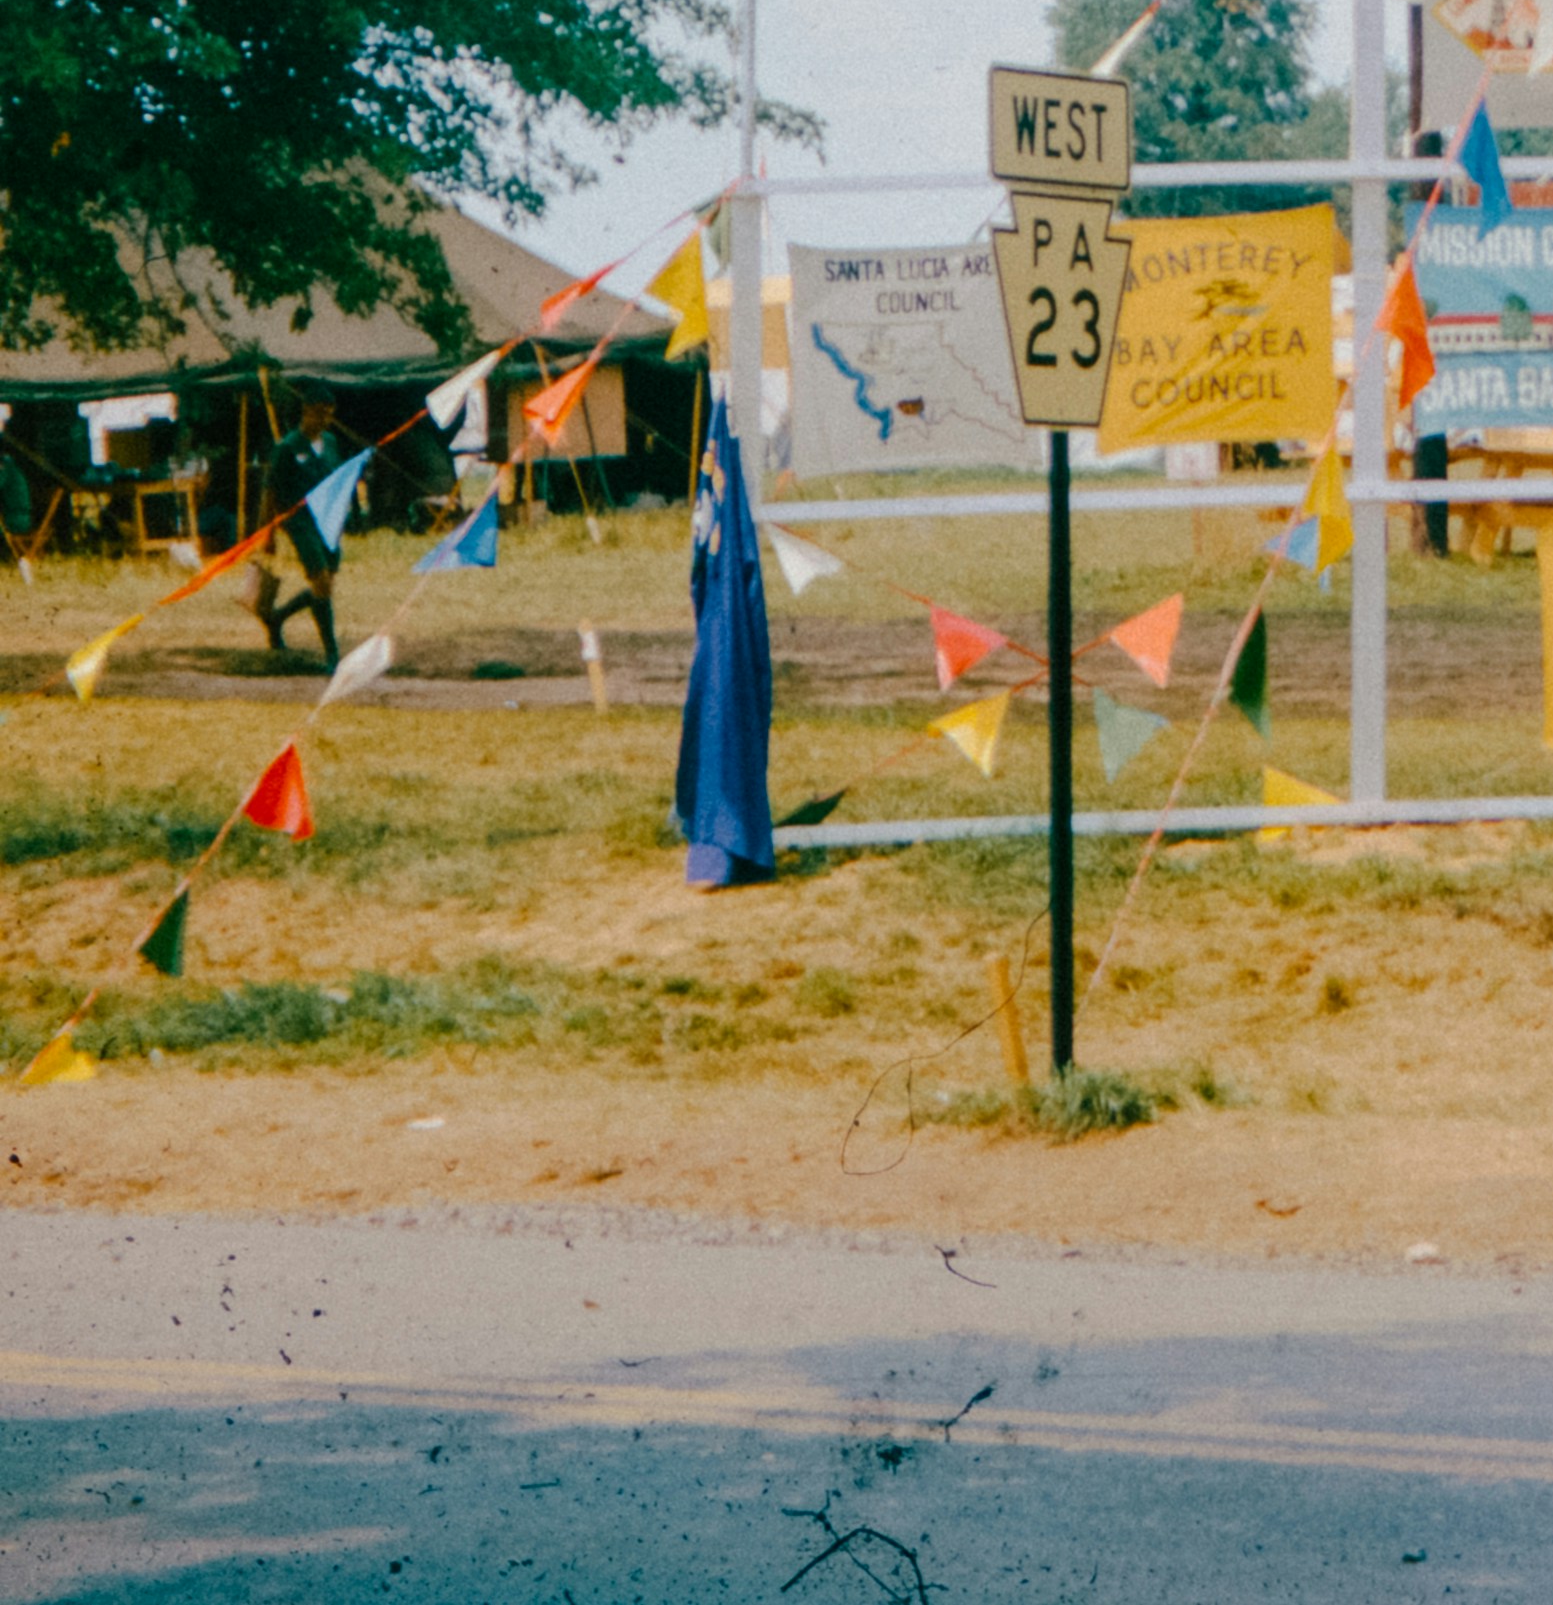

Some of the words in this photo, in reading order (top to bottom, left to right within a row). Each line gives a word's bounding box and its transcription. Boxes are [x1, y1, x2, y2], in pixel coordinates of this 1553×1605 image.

[1012, 95, 1108, 164] WEST
[1419, 221, 1536, 268] MISSION
[824, 258, 885, 282] SANTA
[896, 257, 950, 281] LUCIA
[961, 255, 993, 277] ARE
[876, 291, 962, 314] COUNCIL
[1025, 287, 1102, 370] 23
[1116, 334, 1182, 366] BAY
[1207, 327, 1308, 359] AREA
[1131, 370, 1286, 410] COUNCIL
[1423, 366, 1510, 412] SANTA
